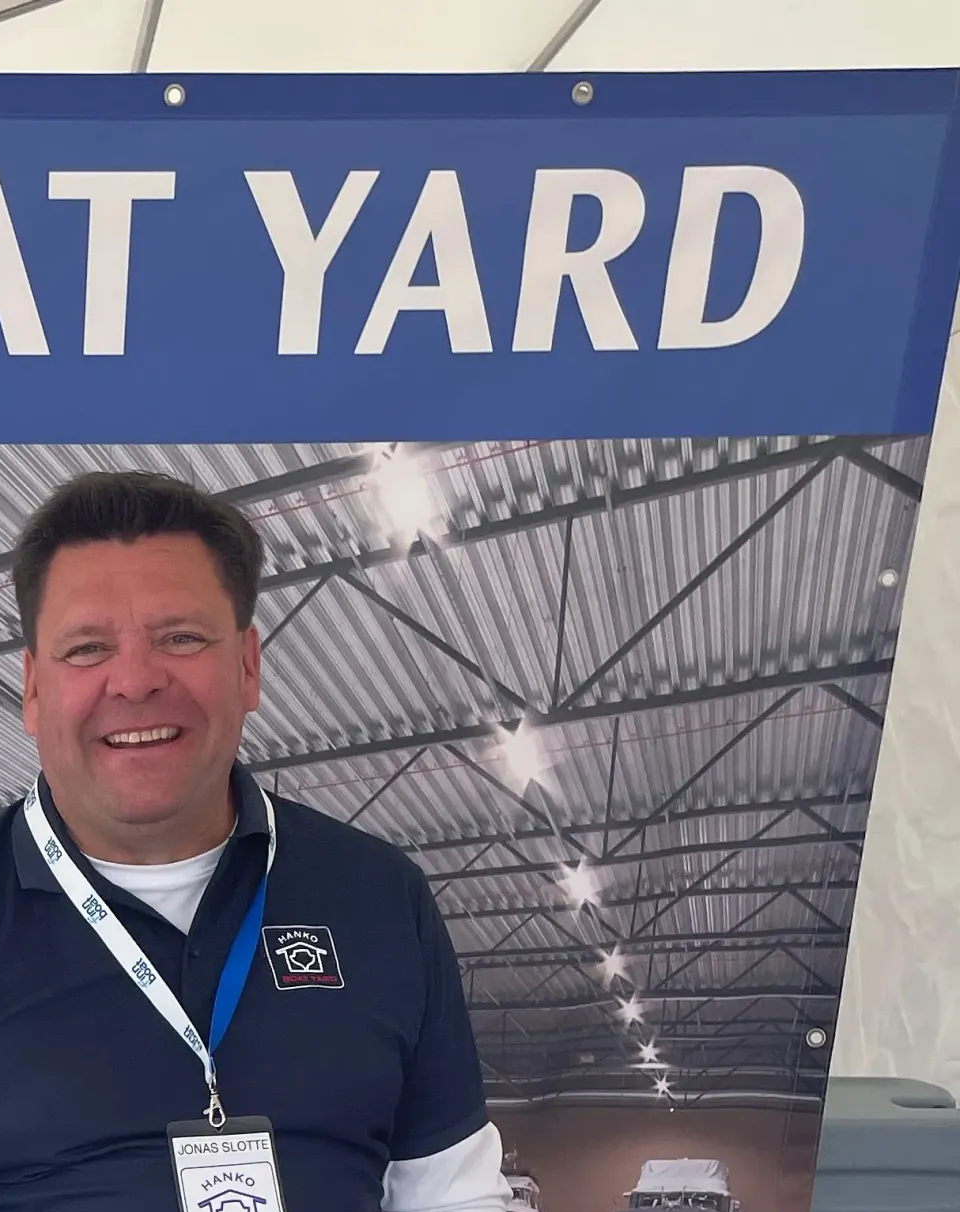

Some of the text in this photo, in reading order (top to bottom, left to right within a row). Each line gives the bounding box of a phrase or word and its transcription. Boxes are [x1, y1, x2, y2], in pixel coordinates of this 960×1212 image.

[244, 166, 804, 354] YARD
[87, 894, 108, 921] boat
[278, 930, 318, 944] HANKO
[136, 957, 156, 985] boat
[178, 1139, 270, 1155] JONAS SLOTTE
[201, 1172, 255, 1191] HANKO
